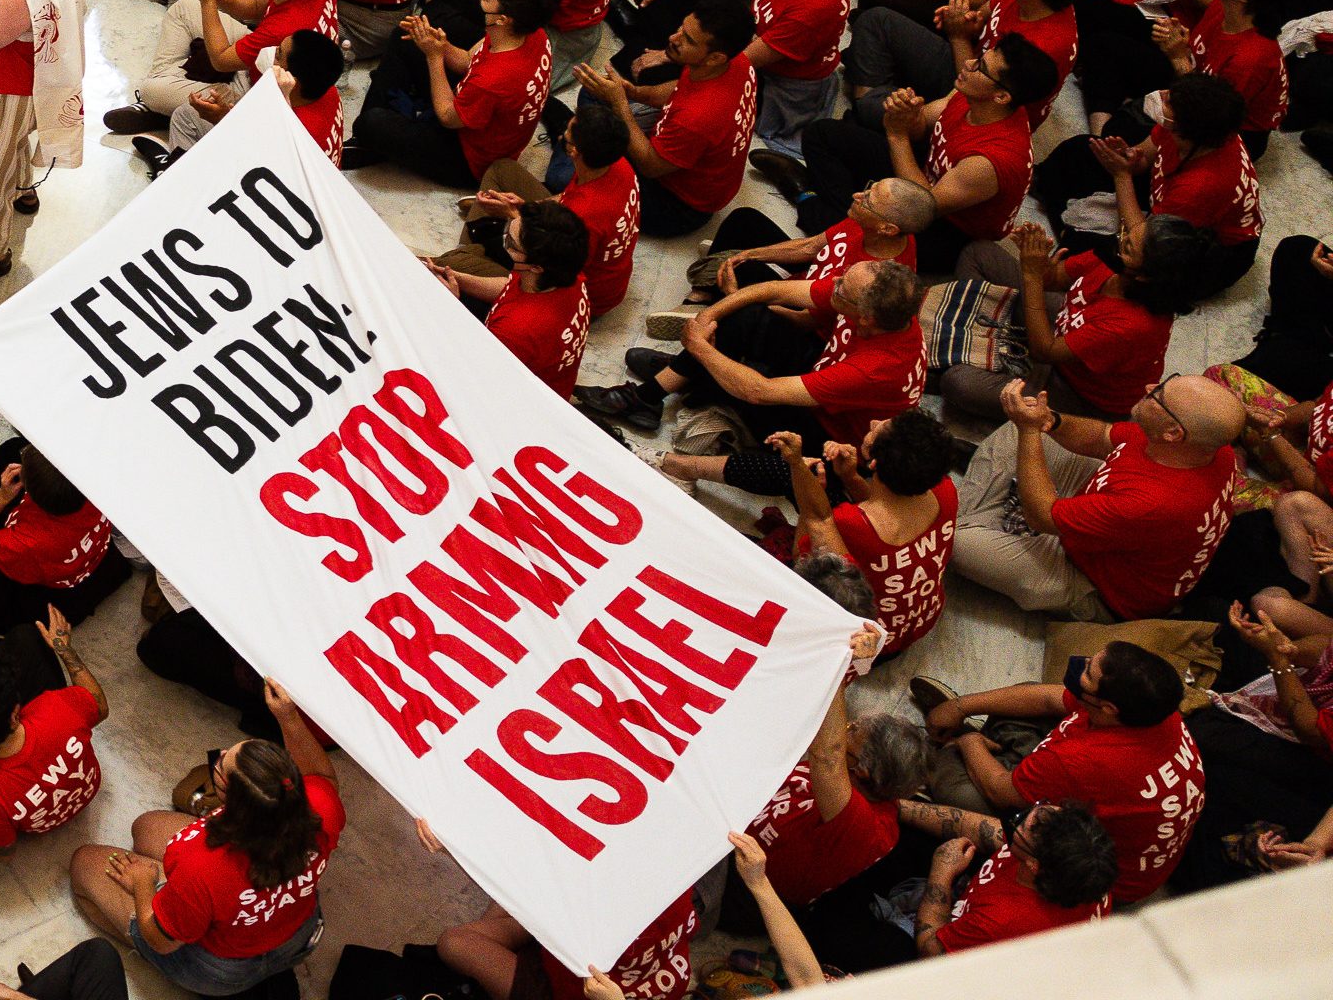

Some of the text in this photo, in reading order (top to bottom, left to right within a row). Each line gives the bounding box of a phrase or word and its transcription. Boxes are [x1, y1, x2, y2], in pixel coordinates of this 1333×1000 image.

[51, 167, 323, 398] JEWS TO
[151, 284, 377, 474] BIDEN:
[259, 367, 471, 582] STOP
[870, 520, 953, 571] JEWS
[884, 548, 946, 594] SAY
[323, 445, 643, 759] ARMING
[13, 736, 84, 821] JEWS
[464, 565, 788, 861] ISRAEL
